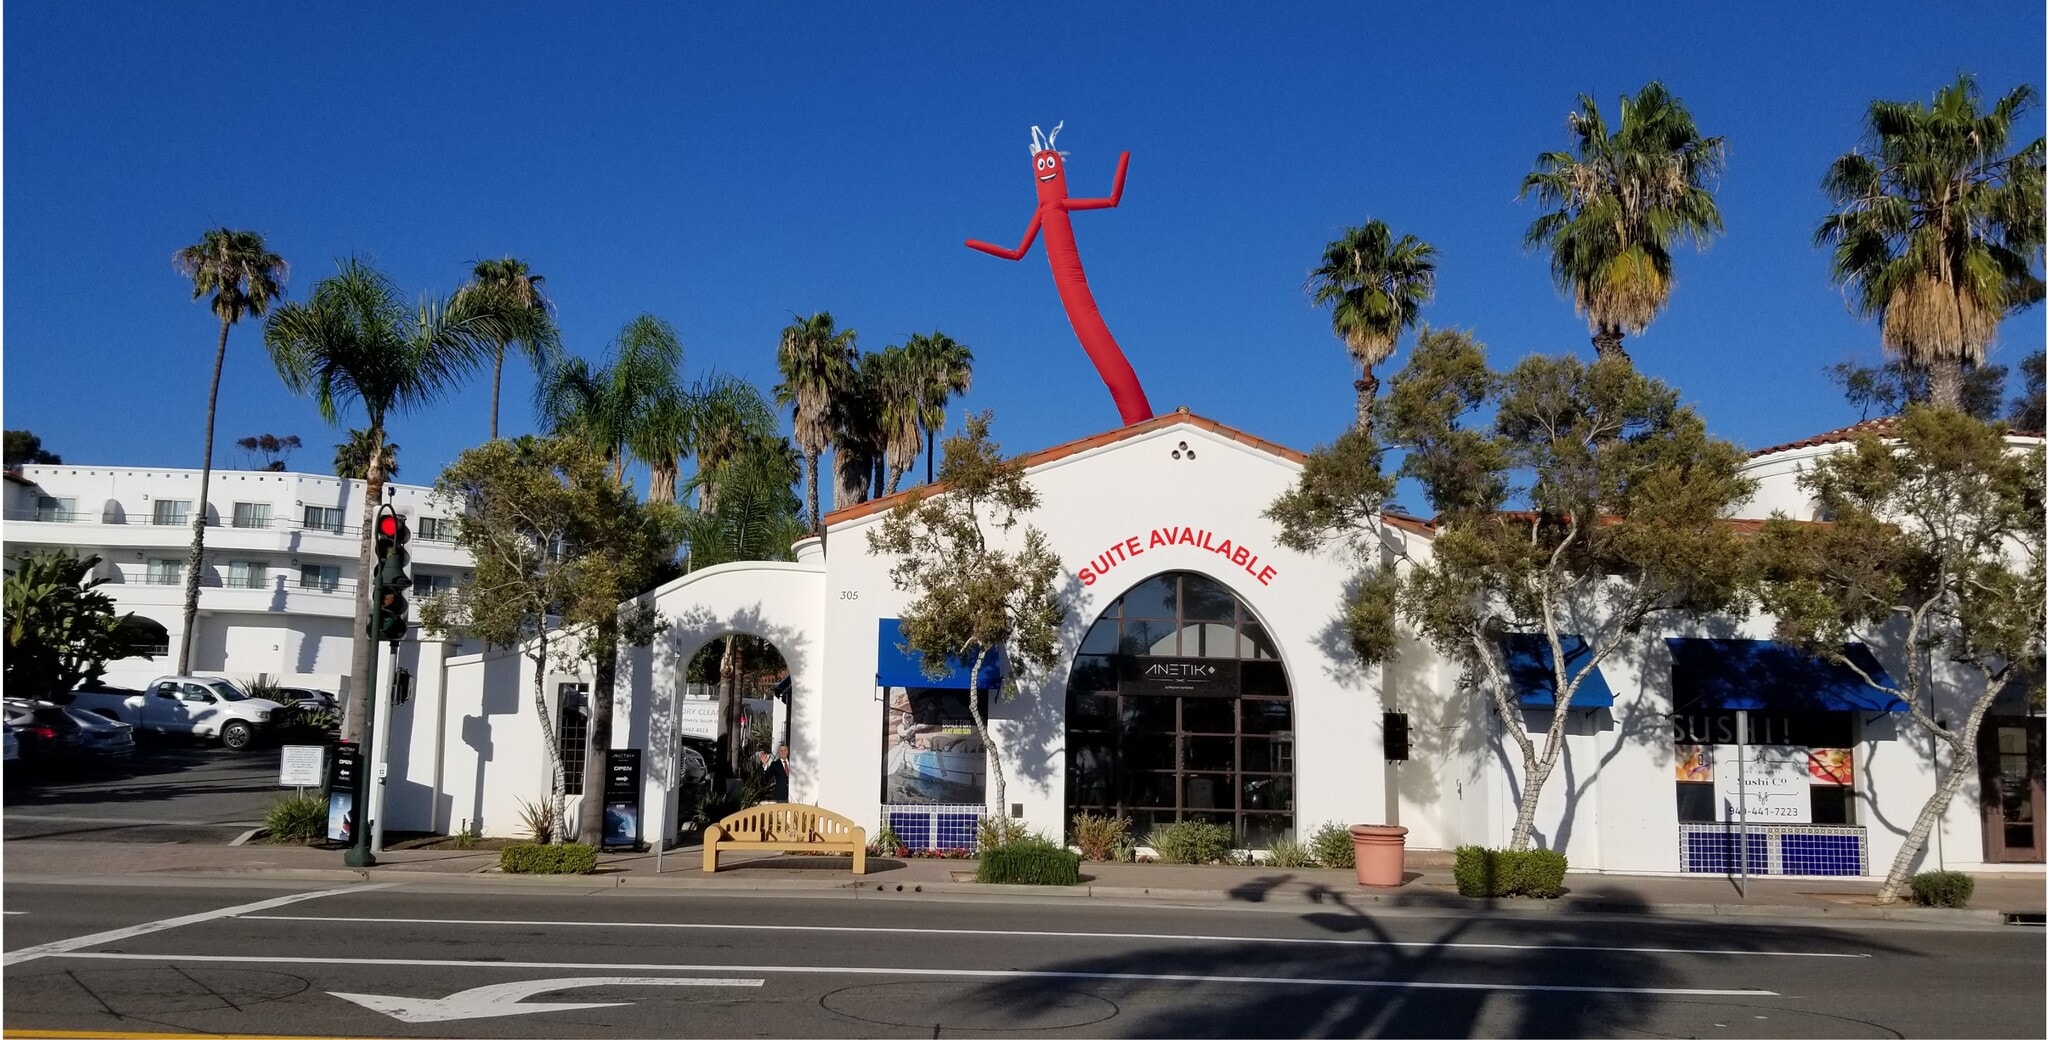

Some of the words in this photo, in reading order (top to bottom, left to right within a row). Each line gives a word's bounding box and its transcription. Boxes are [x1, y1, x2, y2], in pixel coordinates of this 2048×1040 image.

[1078, 536, 1144, 586] SUITE
[1149, 527, 1278, 586] AVAILABLE
[840, 590, 859, 600] 305
[1144, 663, 1207, 676] ANETIK
[1728, 807, 1798, 817] 94-441-7223
